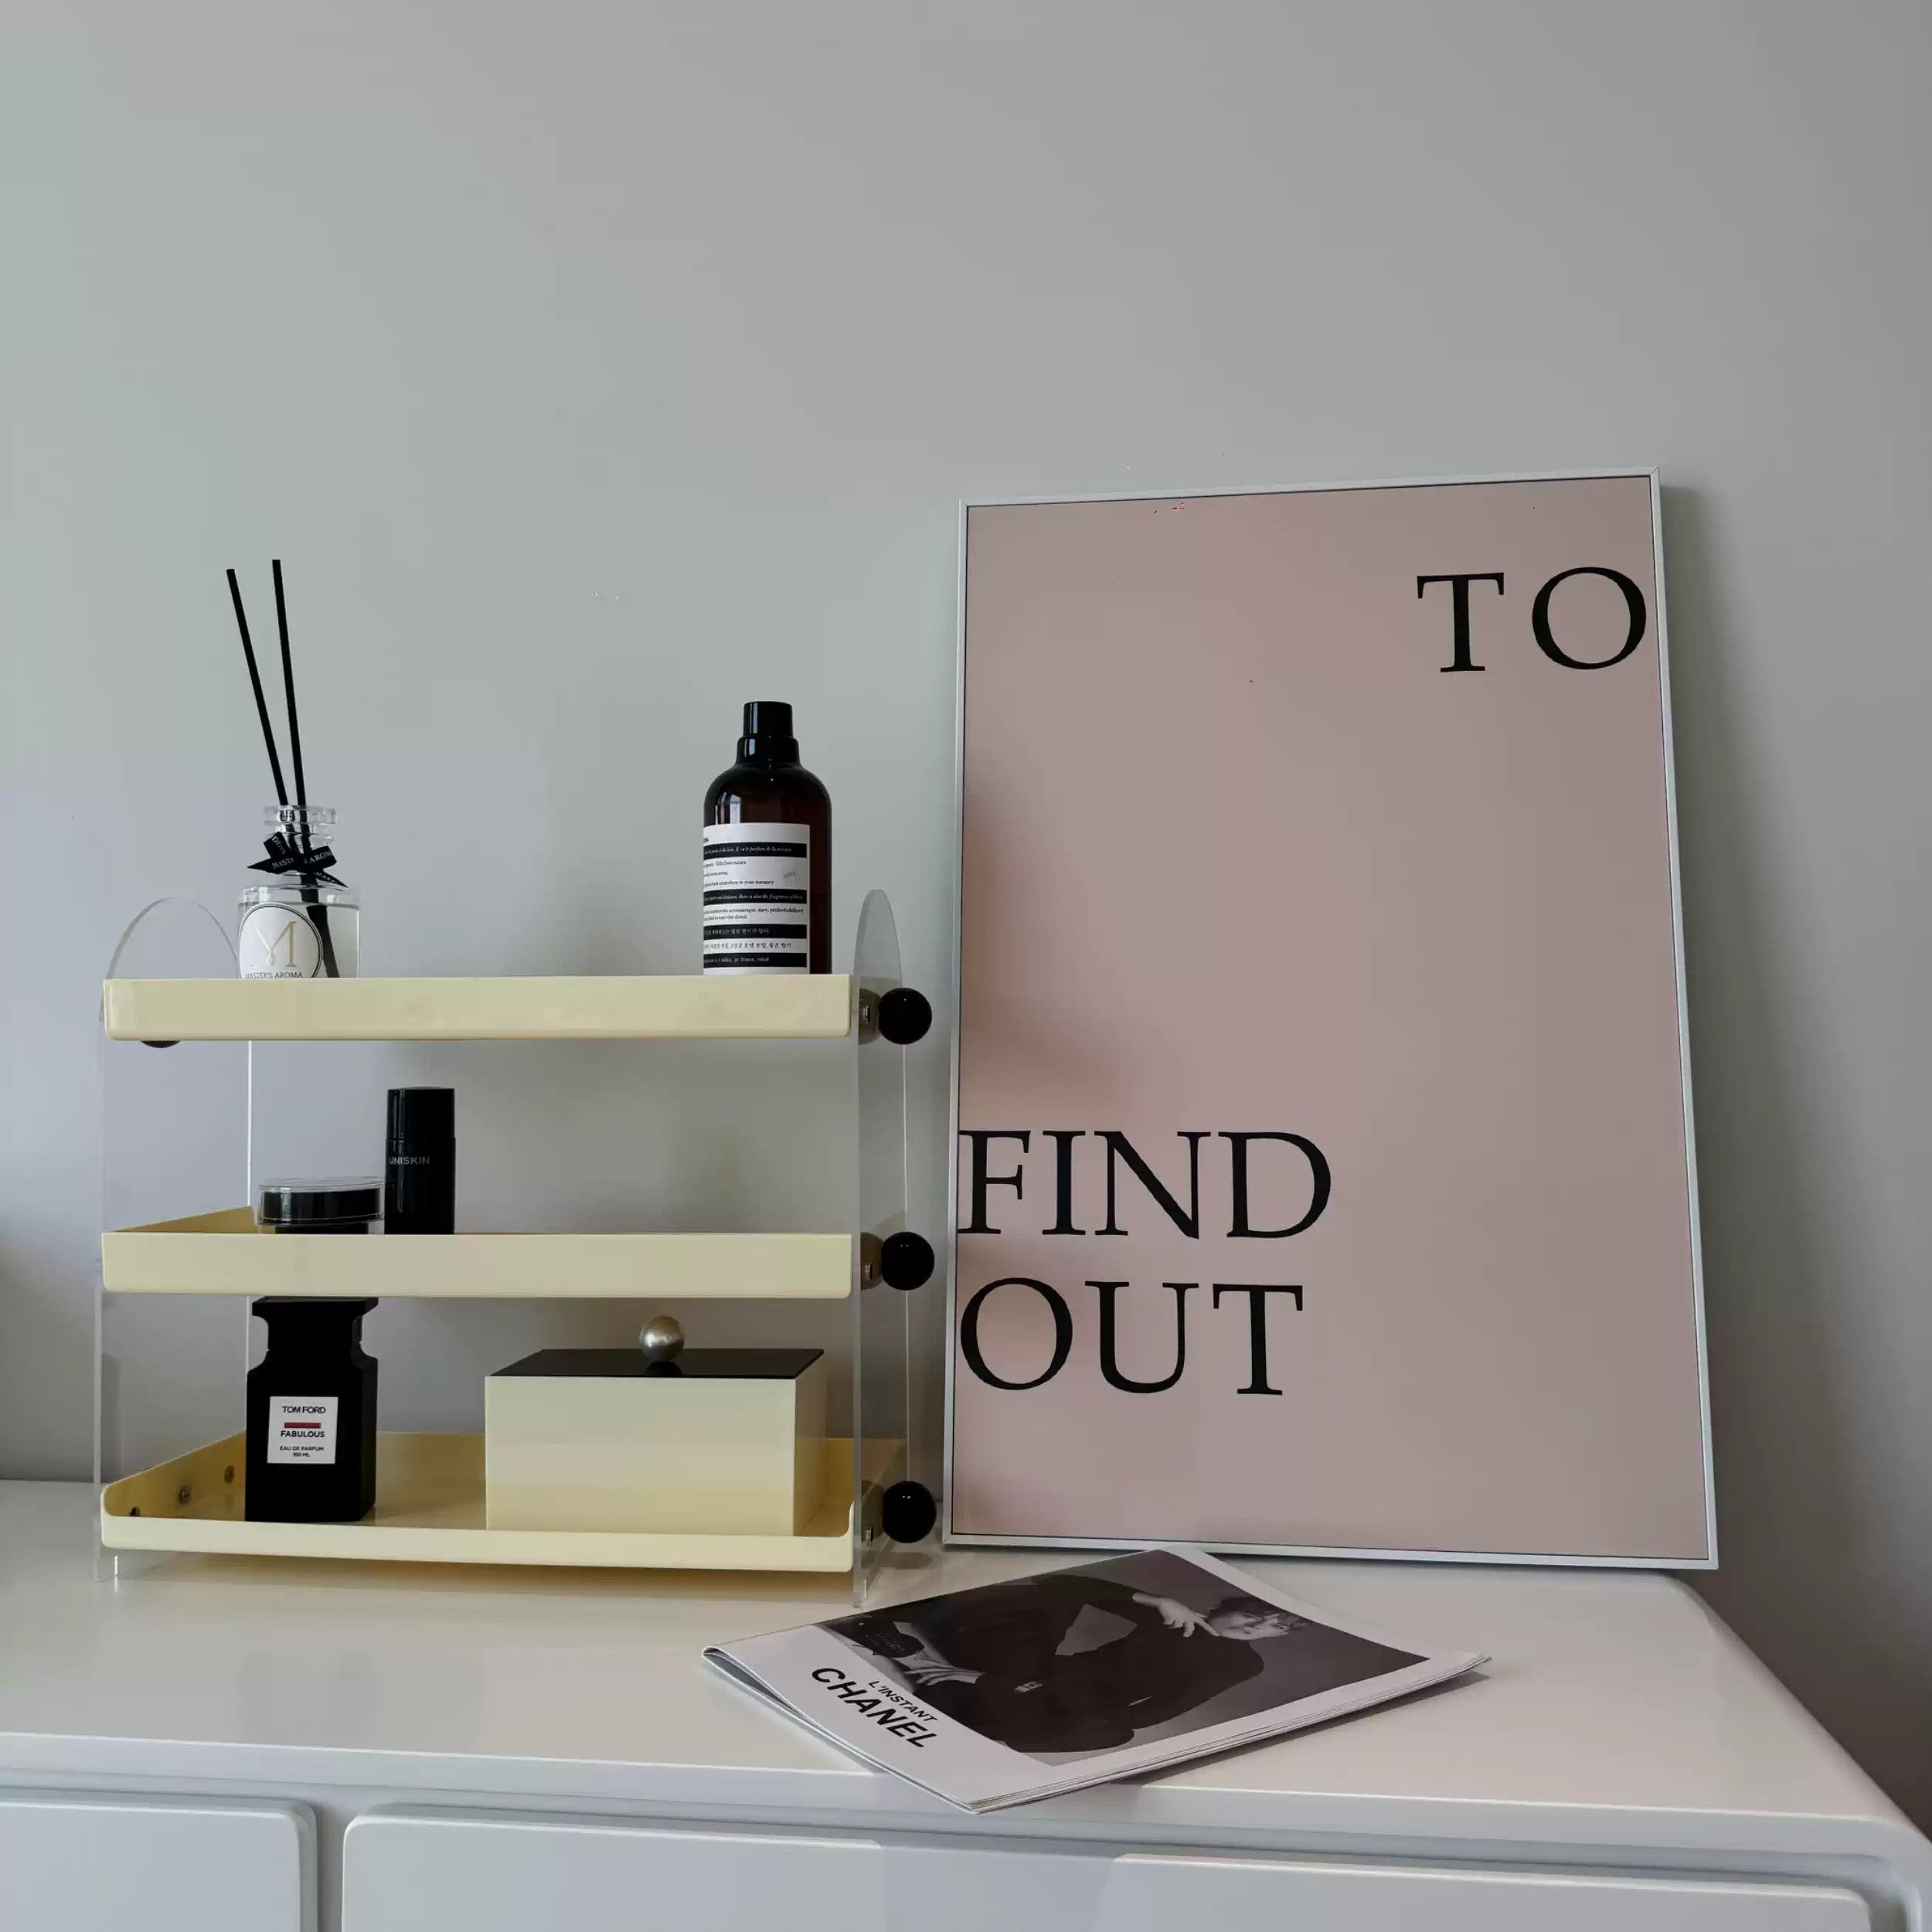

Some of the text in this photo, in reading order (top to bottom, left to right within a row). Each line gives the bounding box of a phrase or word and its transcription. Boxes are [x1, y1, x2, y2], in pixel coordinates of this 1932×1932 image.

[1417, 566, 1647, 672] TO
[389, 1156, 430, 1165] UNISKIN
[957, 1130, 1331, 1240] FIND
[961, 1277, 1303, 1396] OUT
[811, 1668, 937, 1748] CHANEL
[869, 1681, 938, 1722] L'INSTANT
